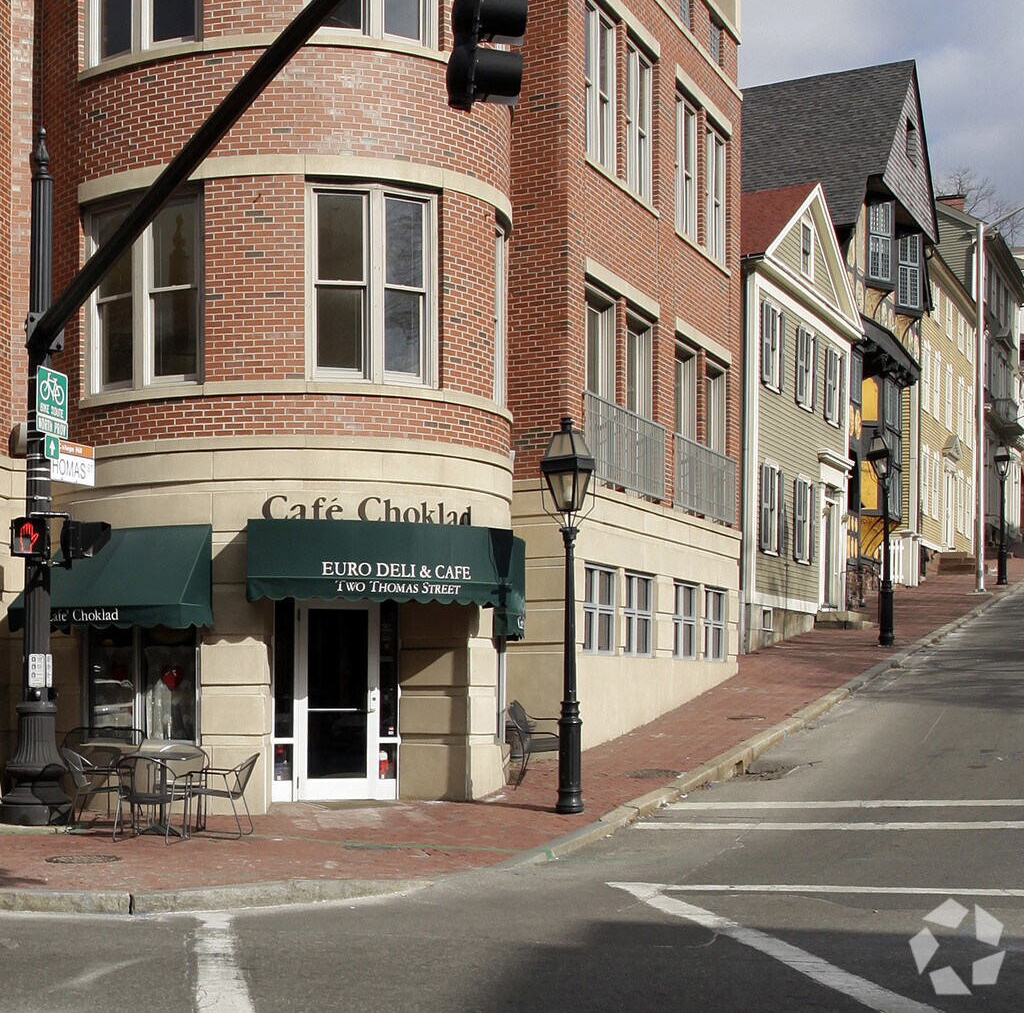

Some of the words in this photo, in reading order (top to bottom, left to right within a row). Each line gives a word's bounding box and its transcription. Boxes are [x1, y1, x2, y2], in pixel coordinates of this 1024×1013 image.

[39, 403, 50, 415] BIKE
[51, 405, 64, 419] ROUTE
[38, 417, 53, 433] NORTH
[53, 421, 66, 437] PROV
[52, 458, 86, 480] HOMAS
[261, 495, 343, 520] Café
[357, 496, 472, 525] Choklad
[321, 561, 372, 577] EURO
[376, 562, 416, 578] DELI
[419, 565, 432, 579] &
[435, 565, 472, 580] CAFE
[334, 580, 365, 592] TWO
[369, 580, 419, 594] THOMAS
[421, 582, 461, 595] STREET
[72, 607, 119, 622] Choklad
